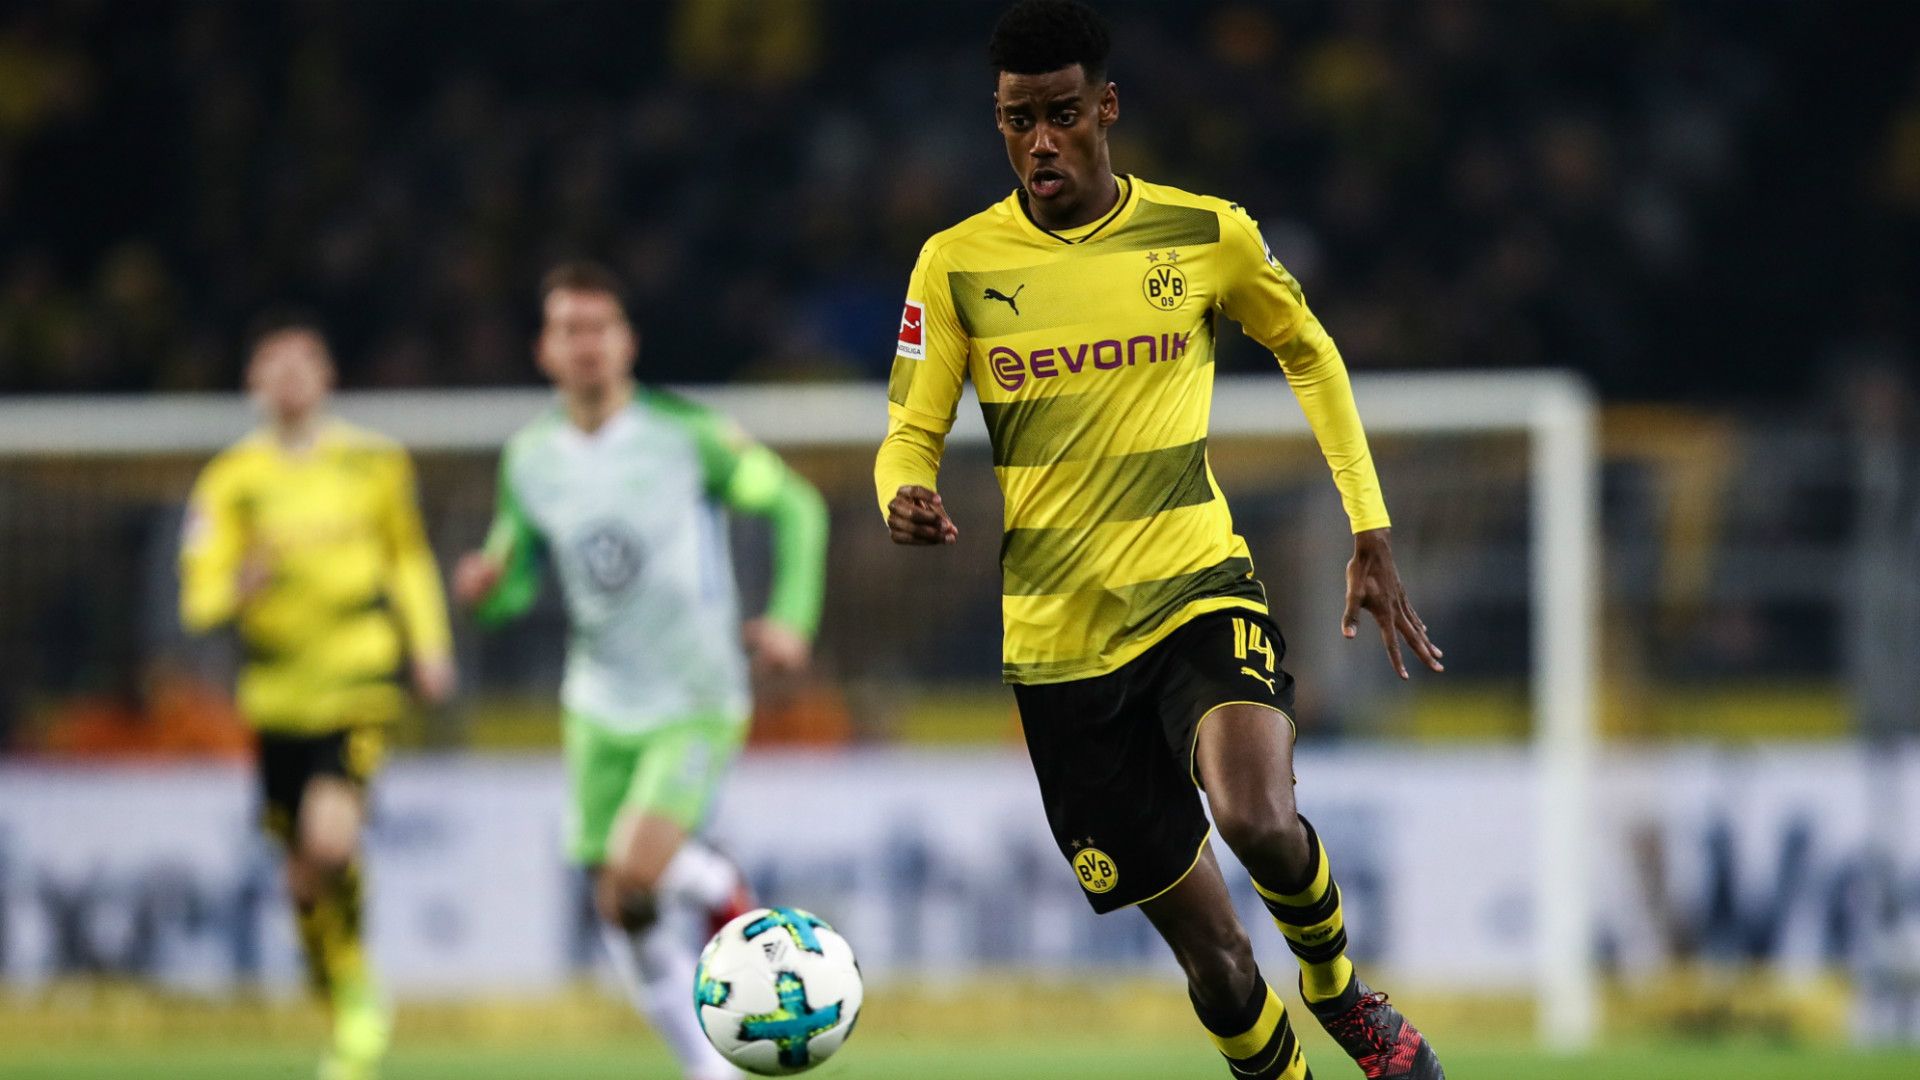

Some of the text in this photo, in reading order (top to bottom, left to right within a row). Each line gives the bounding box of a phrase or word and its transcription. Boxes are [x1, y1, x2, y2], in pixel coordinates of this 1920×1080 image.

[1148, 268, 1183, 297] BVB
[1161, 296, 1174, 307] 09
[1029, 331, 1192, 379] EVONIK
[1232, 617, 1275, 673] 14
[1078, 853, 1112, 882] BVB
